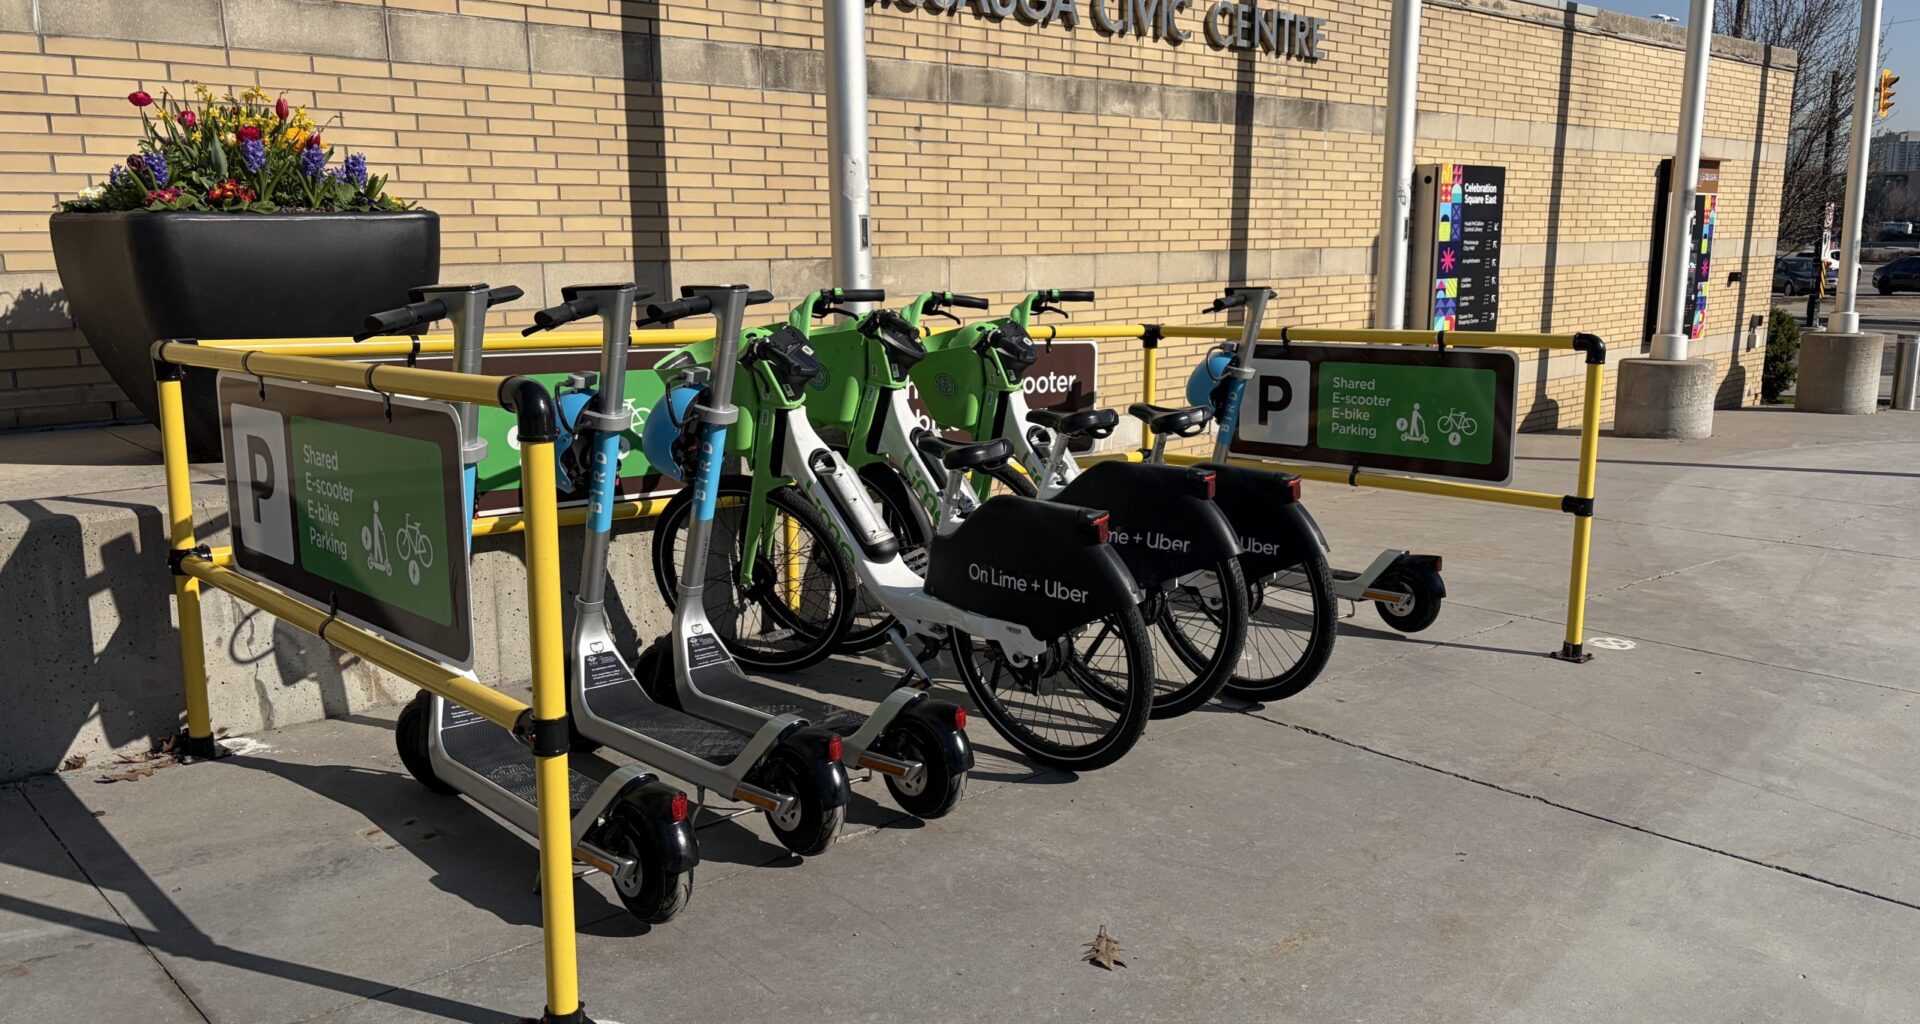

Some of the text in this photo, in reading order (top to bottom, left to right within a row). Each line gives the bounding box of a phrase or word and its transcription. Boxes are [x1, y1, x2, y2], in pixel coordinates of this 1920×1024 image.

[1090, 0, 1192, 43] CIVIC
[1206, 1, 1326, 61] CENTRE
[1464, 182, 1498, 194] Celebration
[1464, 194, 1498, 206] Square East
[1023, 371, 1077, 394] ooter
[1332, 376, 1376, 391] Shared
[1258, 374, 1293, 426] P
[1332, 391, 1392, 407] E-scooter
[1331, 407, 1370, 421] E-bike
[1331, 422, 1377, 439] Parking
[303, 444, 339, 472] Shared
[695, 441, 713, 502] BIRD
[246, 433, 275, 524] P
[305, 471, 354, 504] E-scooter
[590, 450, 608, 514] BIRD
[307, 499, 339, 527] E-bike
[310, 526, 348, 561] Parking
[1146, 531, 1191, 553] Uber
[1240, 536, 1280, 556] Uber
[969, 563, 989, 584] On
[991, 567, 1027, 592] Lime
[1044, 579, 1089, 604] Uber
